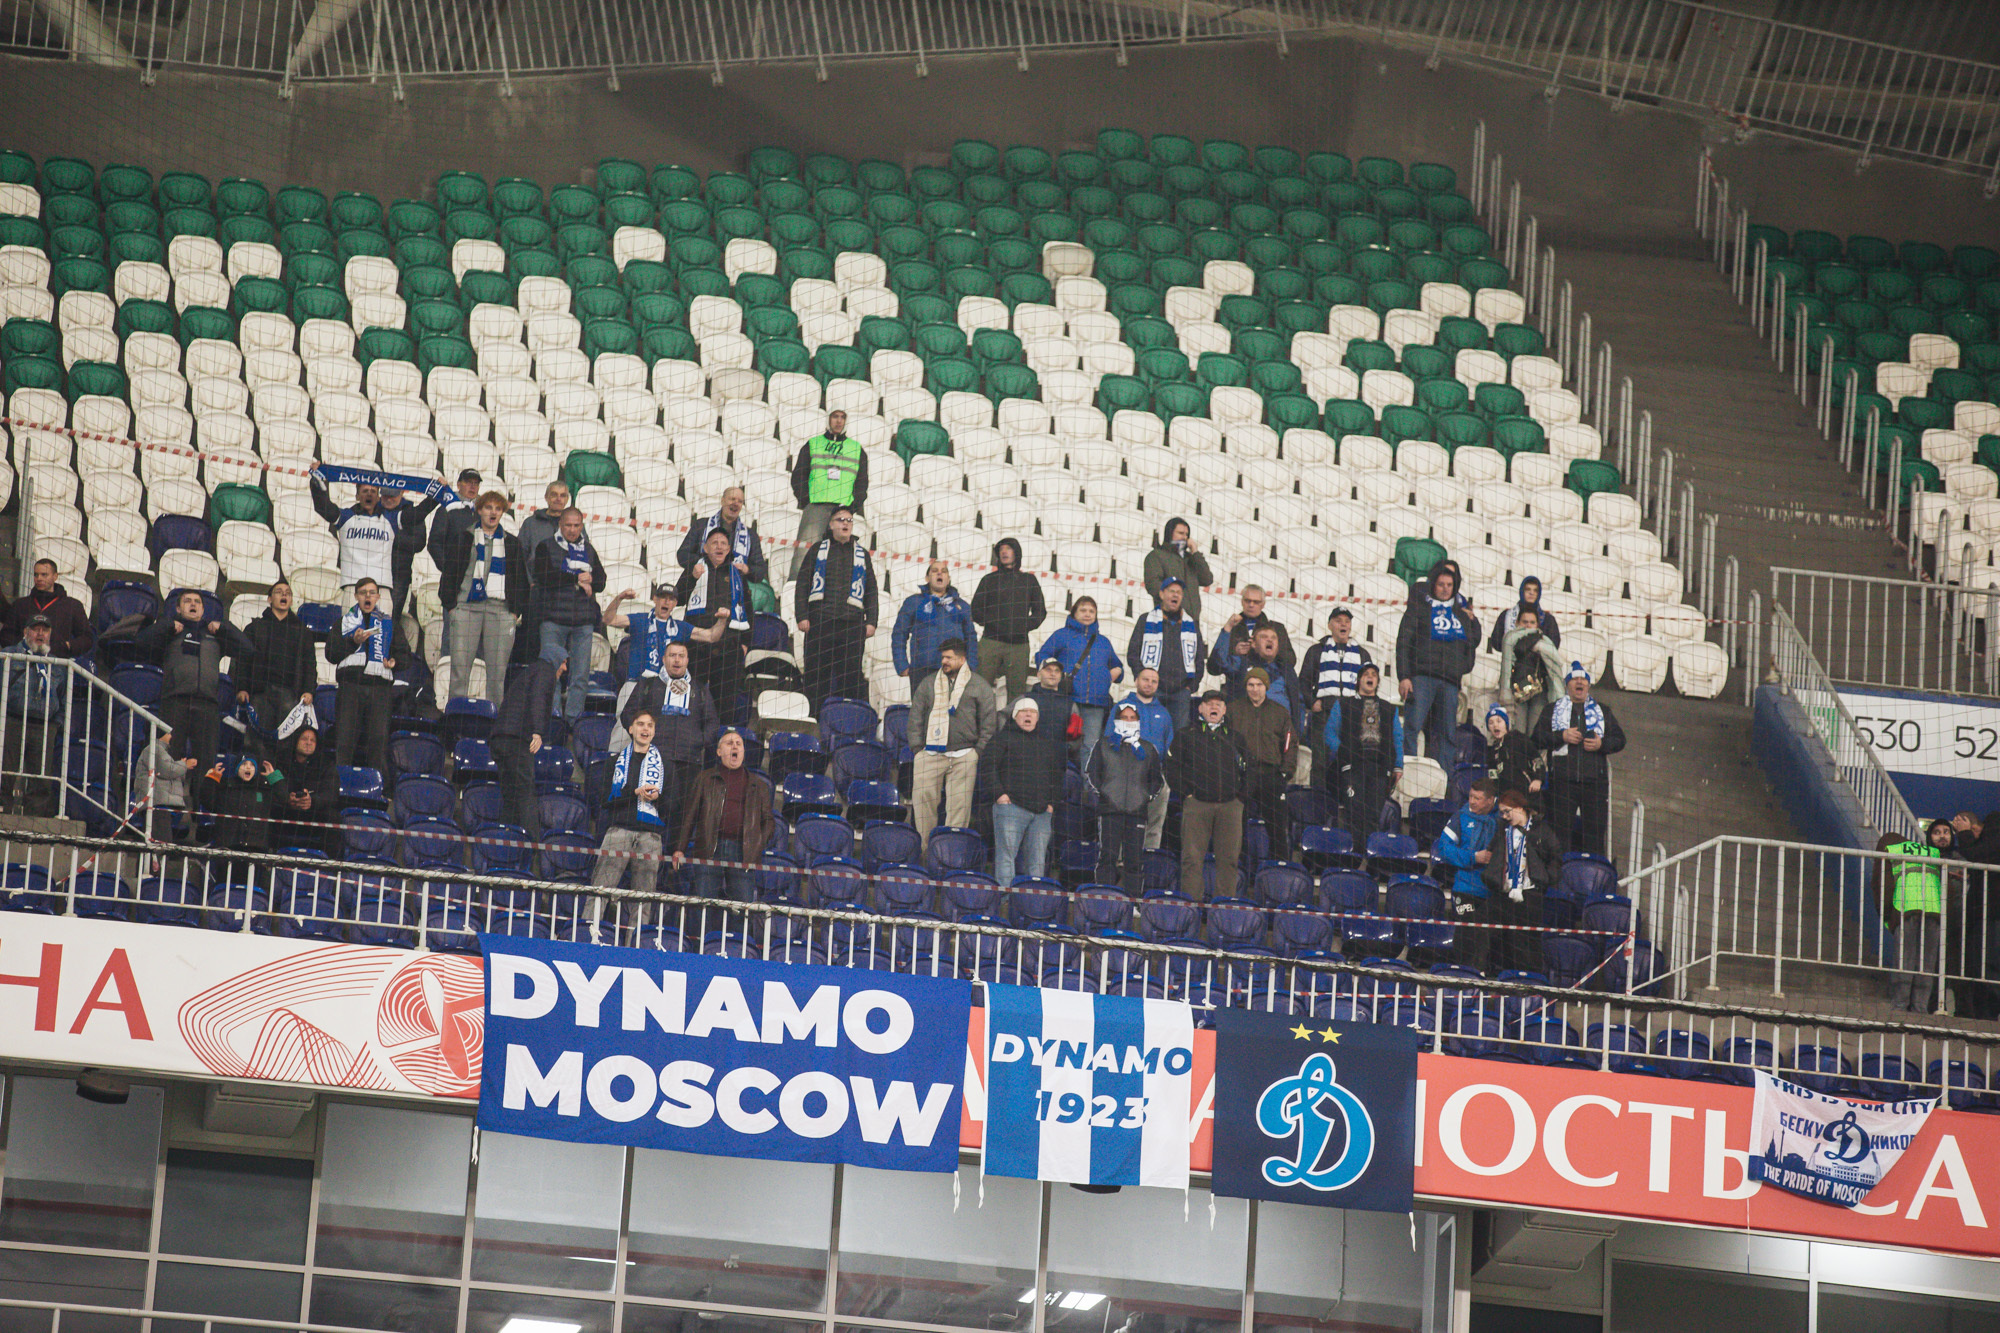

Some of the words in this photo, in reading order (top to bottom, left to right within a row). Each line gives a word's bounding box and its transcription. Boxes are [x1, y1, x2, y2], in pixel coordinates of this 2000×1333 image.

[338, 471, 407, 488] ДИНАМО
[346, 527, 389, 541] ДИНАМО
[1854, 716, 1921, 752] 530
[1954, 725, 1998, 761] 52
[489, 952, 914, 1055] DYNAMO
[991, 1032, 1193, 1077] DYNAMO
[502, 1043, 954, 1147] MOSCOW
[1035, 1088, 1150, 1130] 1923
[1414, 1079, 1764, 1200] ОСТЬ
[1763, 1162, 1782, 1184] THE
[1782, 1169, 1815, 1193] PRIDE
[1816, 1178, 1831, 1197] OF
[1832, 1182, 1872, 1204] MOSCO
